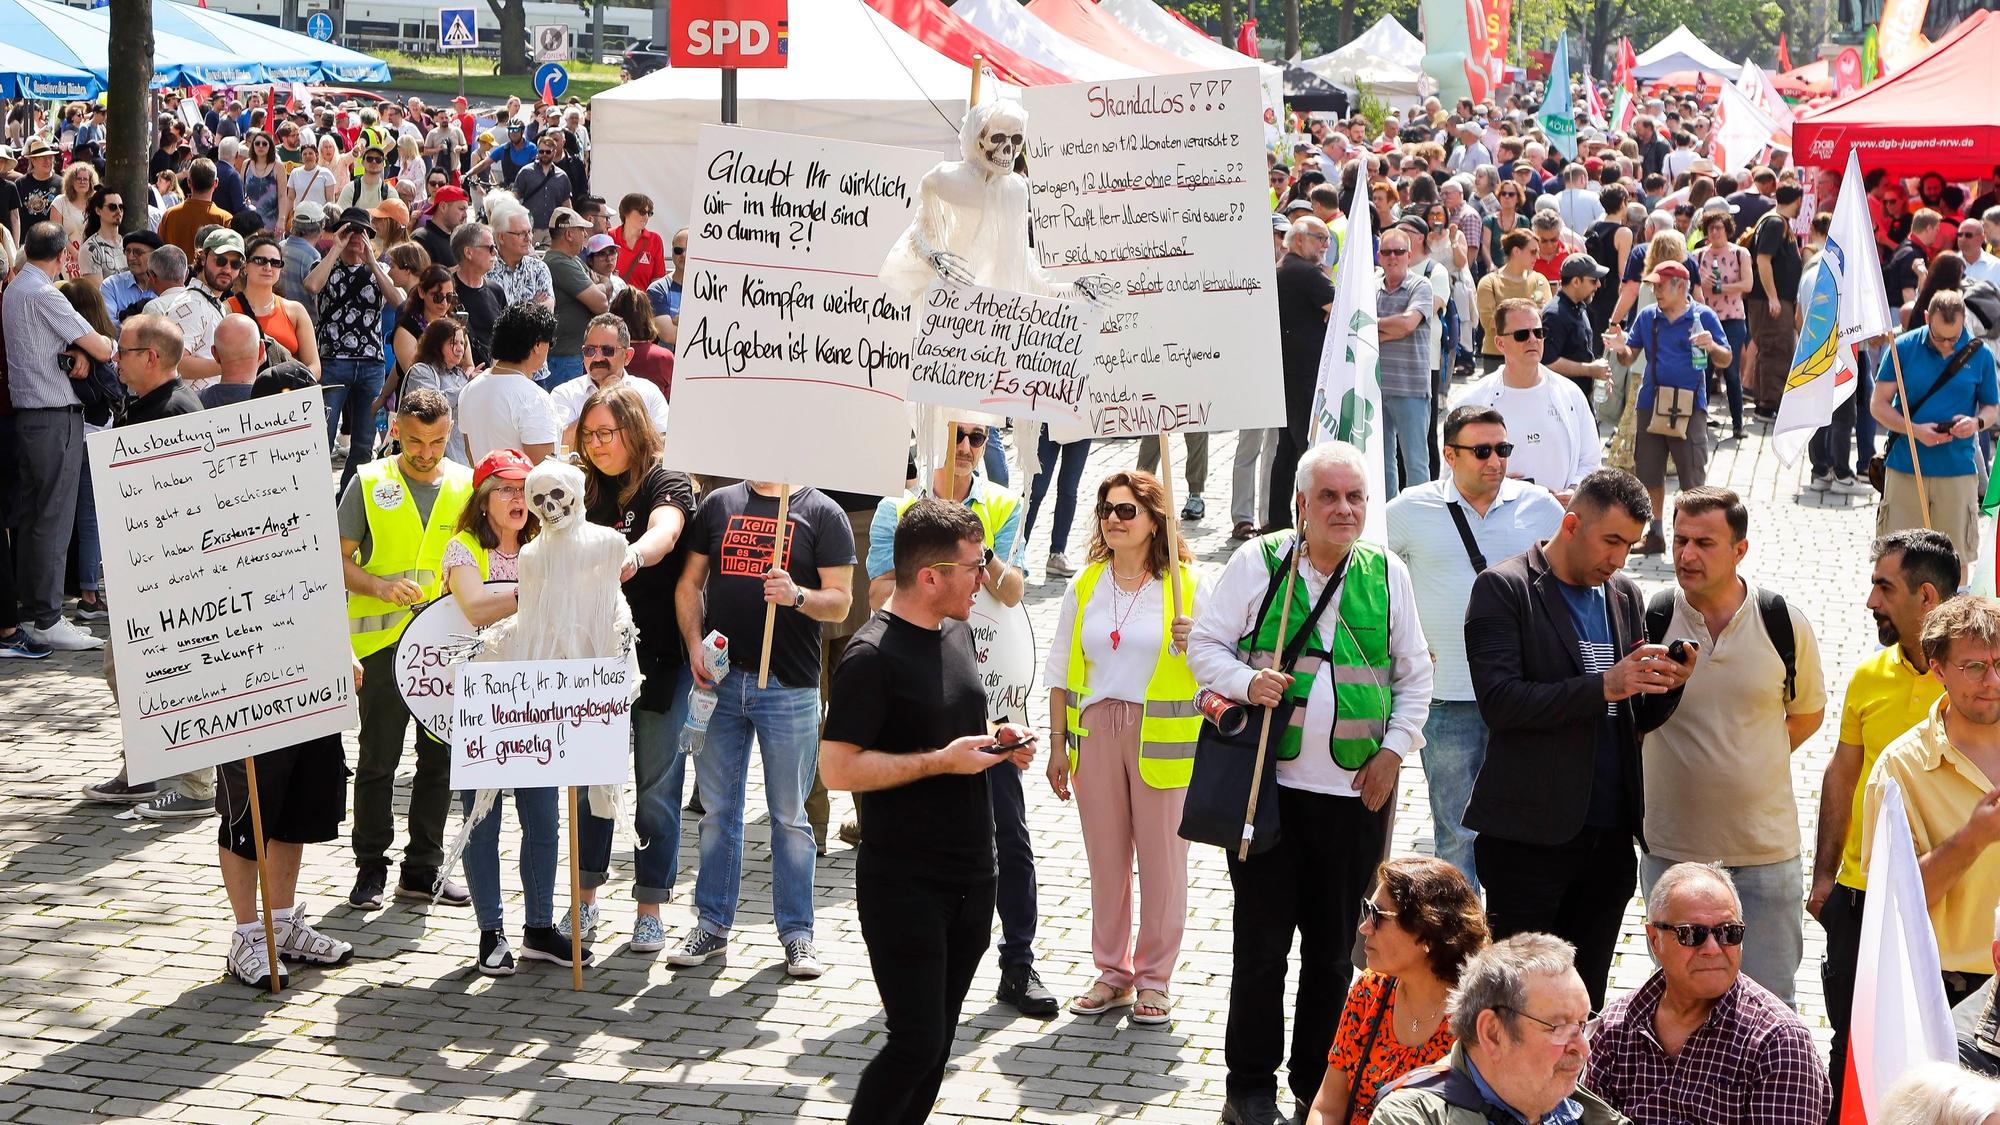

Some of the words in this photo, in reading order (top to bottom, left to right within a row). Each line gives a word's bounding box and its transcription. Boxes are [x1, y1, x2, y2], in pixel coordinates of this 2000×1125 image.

[686, 19, 770, 56] SPD
[1028, 136, 1053, 159] Wir
[1060, 139, 1100, 155] werden
[1139, 136, 1182, 151] Monaten
[1183, 134, 1229, 149] verarscht
[1813, 139, 1835, 150] DGB
[1850, 137, 1974, 149] www.dgb-jugend-nrw.de
[708, 150, 794, 187] Glaubt
[806, 161, 832, 189] Ihr
[840, 169, 912, 208] wirklich,
[1082, 172, 1096, 192] 12
[1097, 170, 1143, 190] Monate
[1144, 172, 1172, 189] ohne
[704, 191, 733, 215] wir
[744, 192, 764, 217] im
[770, 192, 826, 221] Handel
[831, 207, 869, 227] sind
[1033, 207, 1061, 230] Herr
[1099, 204, 1121, 225] Herr
[1181, 206, 1201, 224] sind
[700, 223, 723, 240] so
[727, 220, 781, 248] dumm
[1037, 241, 1060, 265] Ihr
[1065, 242, 1090, 264] seid
[1094, 249, 1108, 262] so
[694, 270, 728, 303] Wir
[742, 274, 814, 322] Kämpfen
[929, 289, 960, 309] Die
[1127, 272, 1163, 296] sofort
[683, 317, 782, 376] Aufgeben
[788, 332, 808, 363] ist
[922, 314, 986, 339] gungen
[991, 320, 1010, 341] im
[1012, 323, 1083, 355] Handel
[917, 337, 967, 361] lassen
[970, 345, 1007, 366] sich
[1016, 352, 1081, 379] rational
[1120, 346, 1139, 370] für
[1140, 348, 1161, 365] alle
[1089, 402, 1212, 436] VERHANDELN
[113, 429, 215, 462] Ausbeutung
[216, 426, 230, 435] im
[119, 481, 143, 498] Wir
[152, 473, 193, 490] haben
[203, 450, 258, 478] JETZT
[125, 516, 149, 532] Uns
[155, 507, 179, 528] geht
[186, 505, 201, 516] es
[215, 483, 288, 509] beschissen
[129, 549, 154, 567] Wir
[161, 544, 194, 558] haben
[201, 512, 299, 551] Existenz-Angst
[726, 530, 757, 545] jeck
[741, 519, 776, 533] kein
[137, 582, 159, 594] uns
[168, 569, 205, 585] droht
[212, 564, 228, 575] die
[236, 541, 307, 569] Altersarmut
[736, 548, 749, 557] es
[127, 618, 150, 640] Ihr
[159, 591, 253, 632] HANDELT
[264, 593, 286, 605] seit
[300, 580, 328, 601] Jahr
[142, 646, 167, 656] mit
[177, 632, 219, 647] unseren
[226, 626, 263, 639] Leben
[273, 617, 295, 627] und
[146, 663, 192, 679] unserer
[201, 642, 264, 665] Zukunft
[984, 670, 1003, 687] der
[139, 683, 227, 716] Übernehmt
[245, 664, 305, 689] ENDLICH
[464, 674, 481, 699] Hr.
[481, 672, 535, 704] Ranft,
[537, 670, 553, 691] Hr.
[556, 671, 571, 690] Dr.
[574, 676, 590, 688] von
[592, 664, 626, 689] Moers
[161, 687, 332, 745] VERANTWORTUNG
[460, 708, 487, 727] Ihre
[464, 735, 488, 759] ist
[495, 735, 552, 765] gruselig
